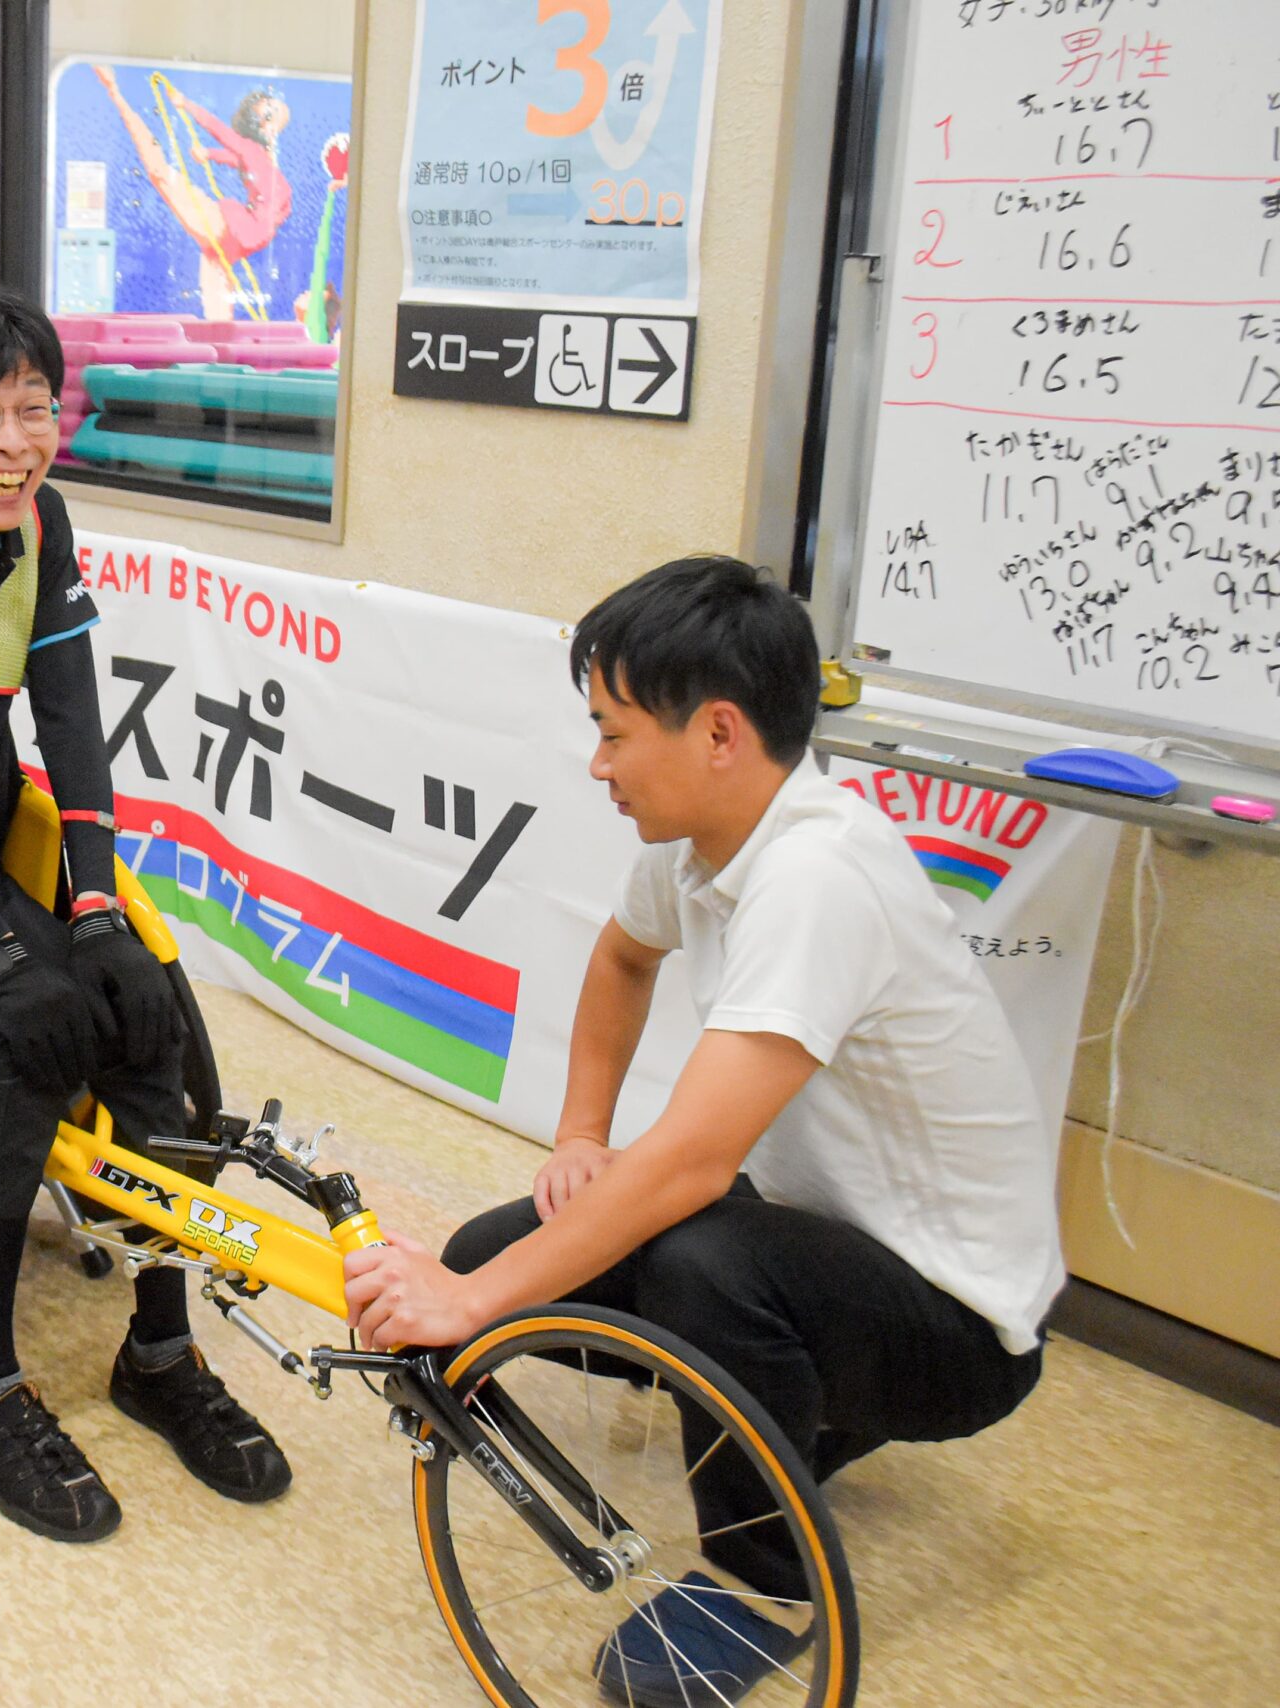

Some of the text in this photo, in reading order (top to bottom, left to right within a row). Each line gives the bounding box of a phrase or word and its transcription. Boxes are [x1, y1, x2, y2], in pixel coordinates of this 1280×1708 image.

[441, 56, 526, 88] ポイント
[524, 0, 612, 138] 3
[1056, 28, 1171, 87] 男性
[620, 73, 644, 102] 倍
[933, 115, 953, 160] 1
[413, 160, 469, 186] 通常時
[589, 178, 686, 228] 30p
[913, 209, 963, 268] 2
[407, 331, 535, 378] スロープ
[910, 312, 939, 379] 3
[78, 546, 342, 664] EAM BEYOND
[183, 1219, 259, 1266] SPORTS
[471, 1441, 533, 1506] REV
